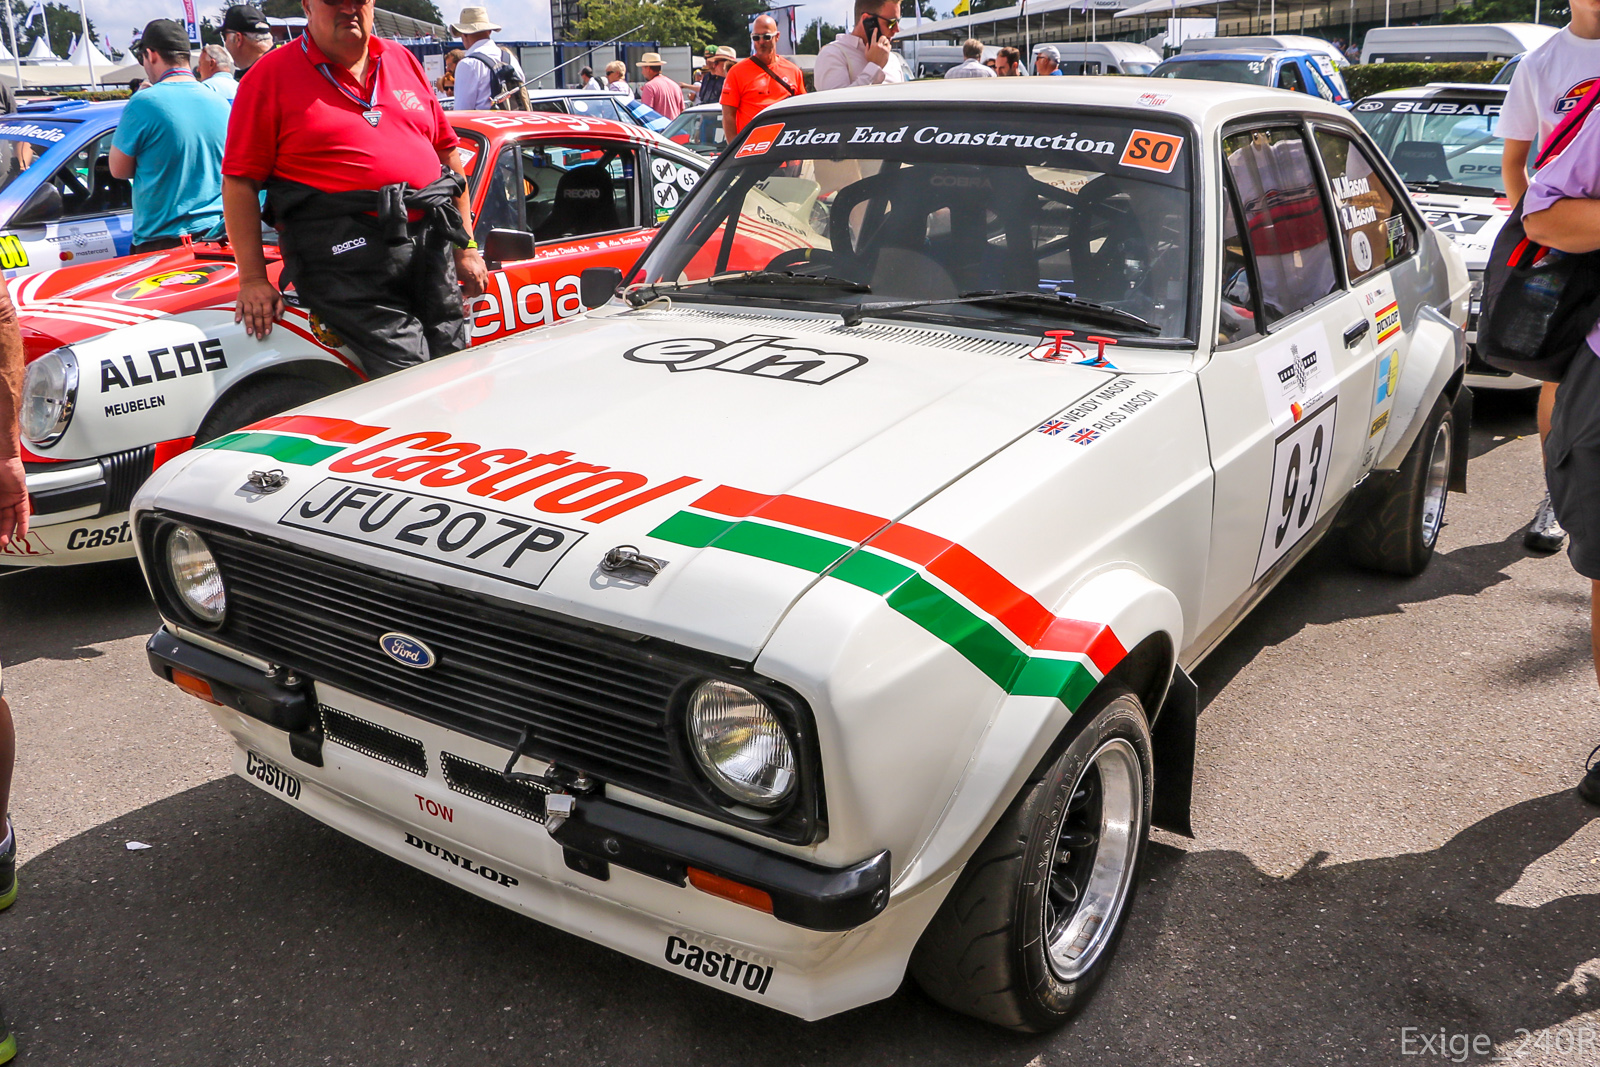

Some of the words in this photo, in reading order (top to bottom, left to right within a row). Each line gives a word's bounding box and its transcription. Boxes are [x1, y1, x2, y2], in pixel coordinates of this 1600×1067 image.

[0, 124, 66, 142] amMedia
[470, 114, 607, 131] Belga
[776, 128, 840, 147] Eden
[847, 125, 909, 145] End
[913, 126, 1115, 155] Construction
[1128, 136, 1174, 163] SO
[563, 188, 600, 199] RECARO
[76, 248, 108, 257] mastercard
[332, 237, 366, 254] sparco
[468, 271, 588, 338] elga
[101, 338, 228, 393] ALCOS
[104, 395, 166, 418] MEUBELEN
[1060, 398, 1103, 422] WENDY
[1096, 378, 1136, 401] MASON
[1092, 411, 1127, 432] RUSS
[1119, 389, 1159, 414] MASON
[327, 431, 702, 524] Castrol
[1275, 424, 1324, 549] 93
[298, 484, 401, 535] JFU
[400, 504, 566, 569] 207P
[391, 639, 420, 662] Ford
[245, 750, 303, 801] Castrol
[414, 793, 454, 823] TOW
[403, 831, 520, 889] DUNLOP
[664, 934, 775, 996] Castrol
